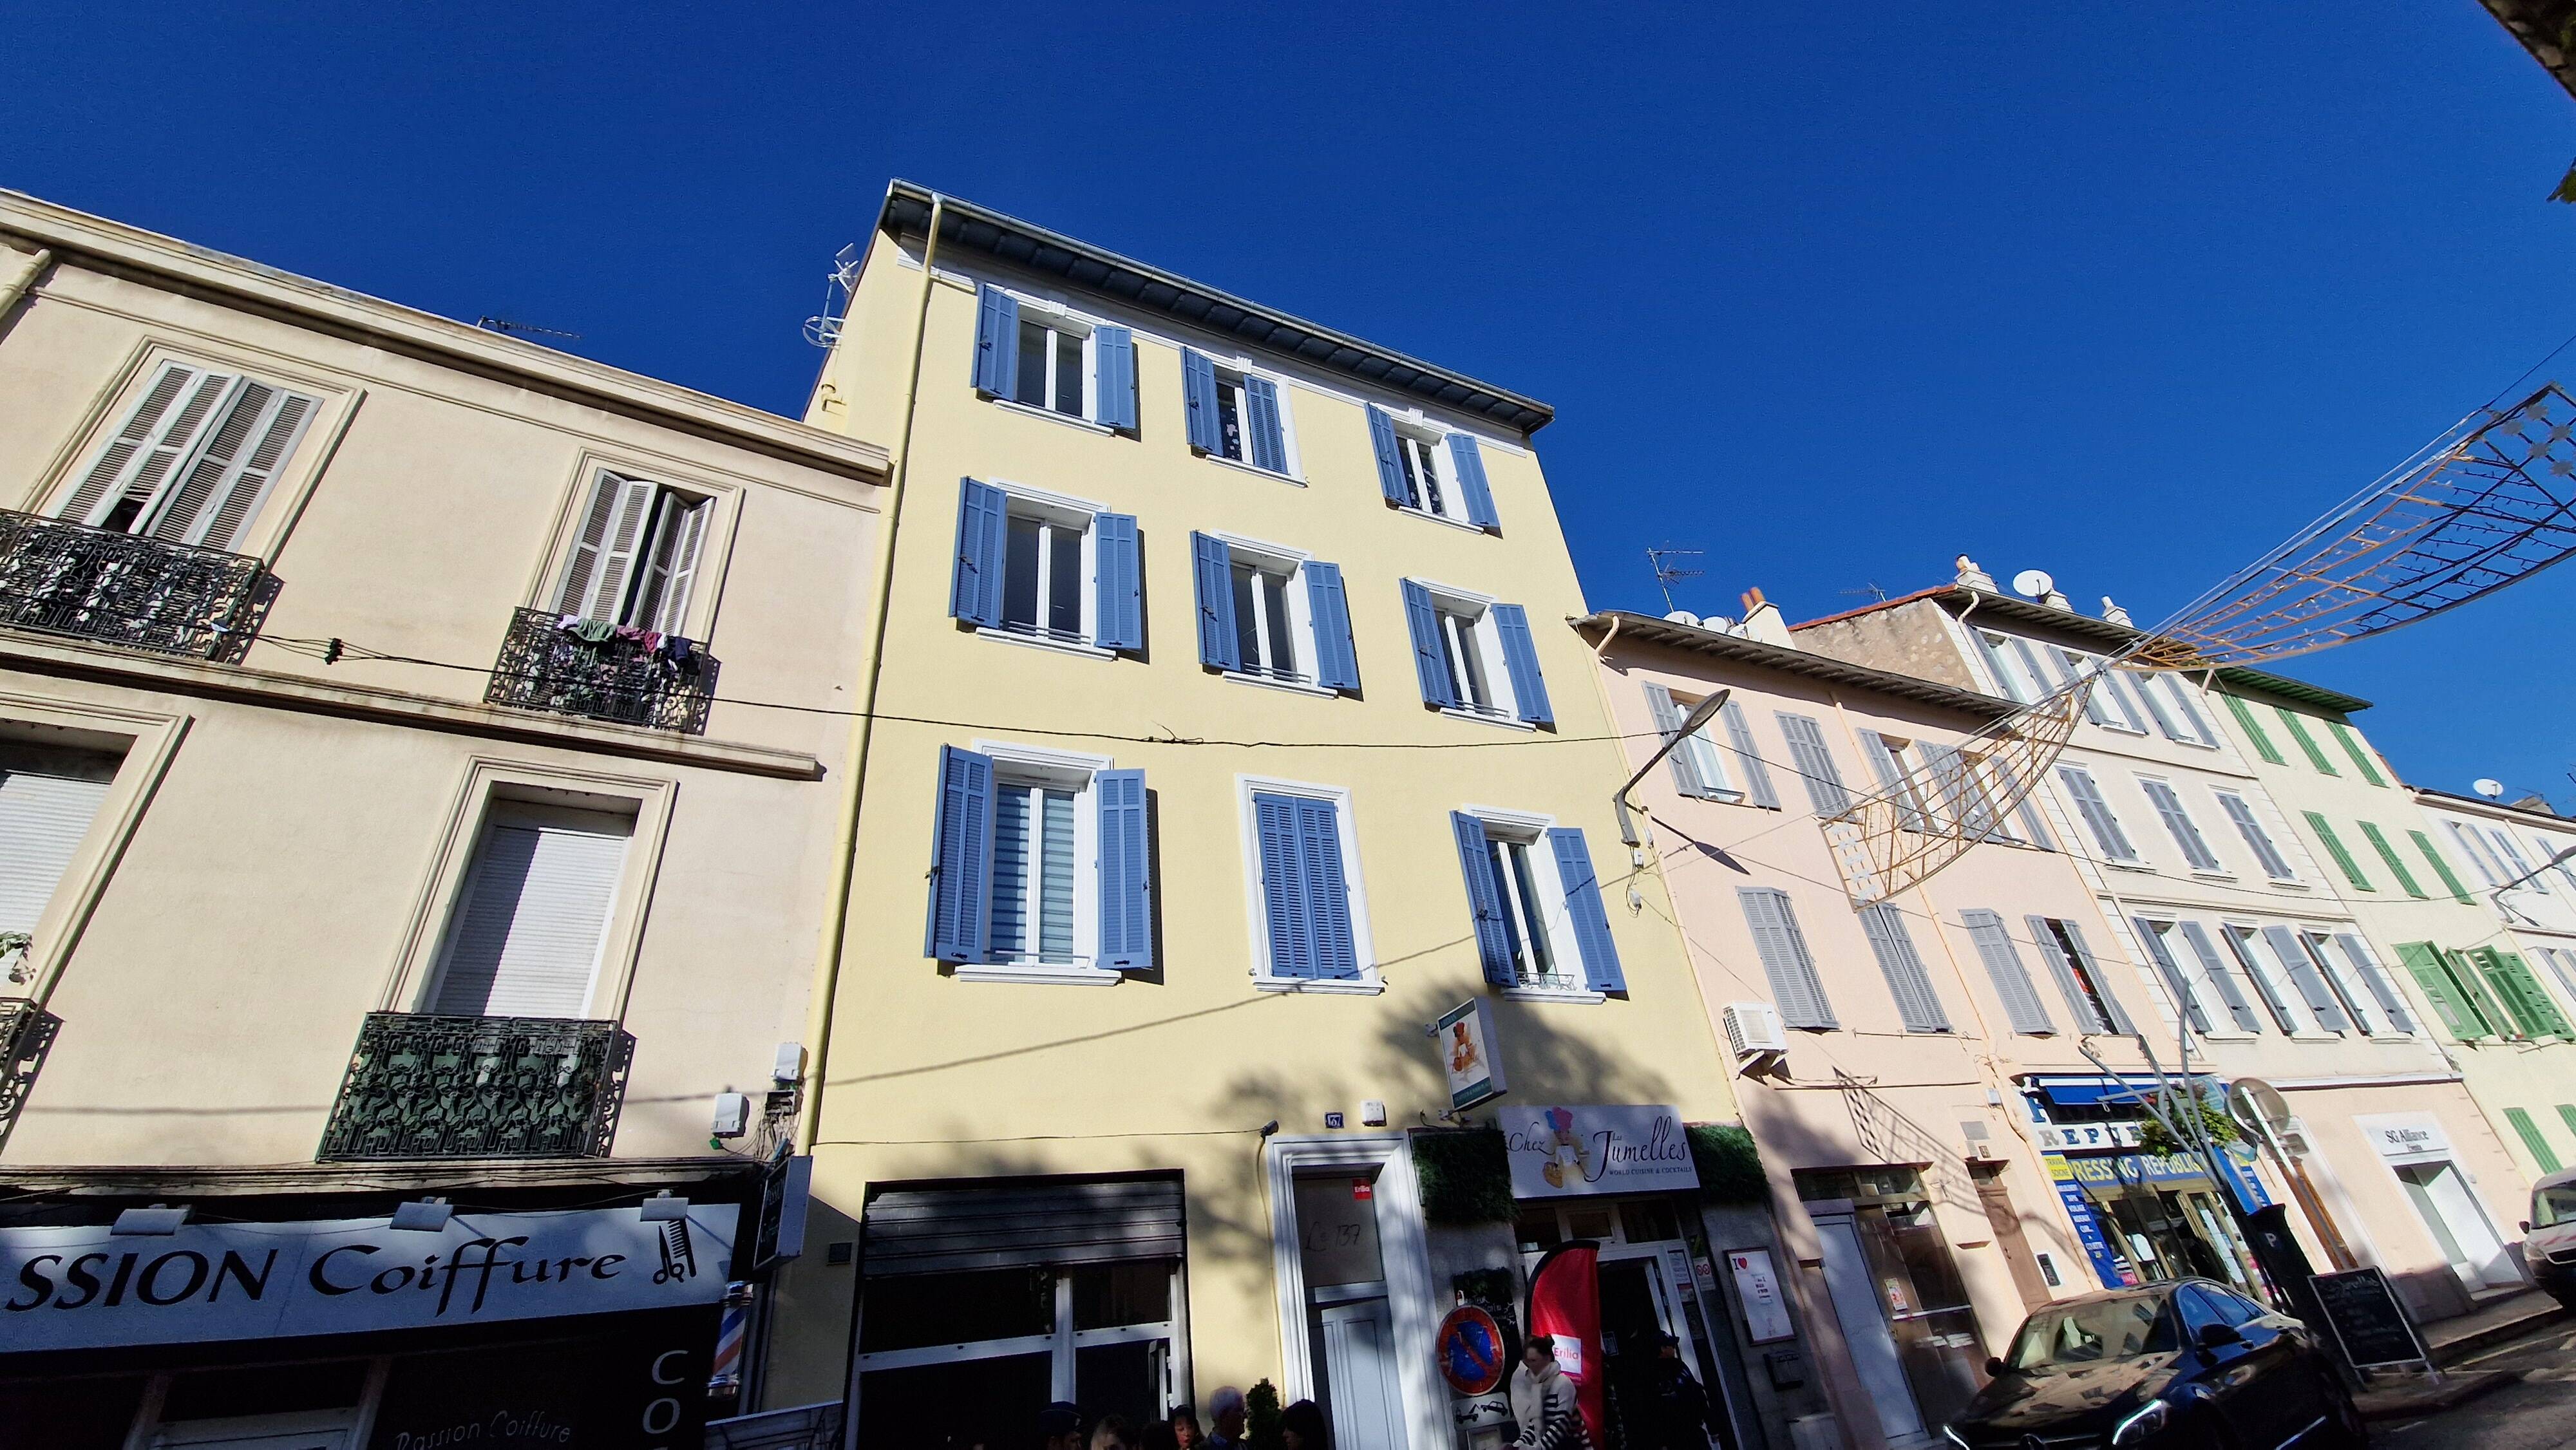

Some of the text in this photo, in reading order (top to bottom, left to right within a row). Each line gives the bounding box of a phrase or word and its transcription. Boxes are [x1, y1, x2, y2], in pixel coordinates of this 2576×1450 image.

[1508, 1122, 1555, 1155] Chez
[1584, 1116, 1686, 1183] Jumelles
[2038, 1126, 2143, 1146] REPUB
[2385, 1130, 2400, 1143] SG
[2068, 1157, 2139, 1182] RESSNG
[5, 1236, 627, 1317] SSION Coiffure
[1553, 1346, 1580, 1361] Erilia
[643, 1350, 688, 1450] CO
[396, 1409, 573, 1450] Passion Coiffure
